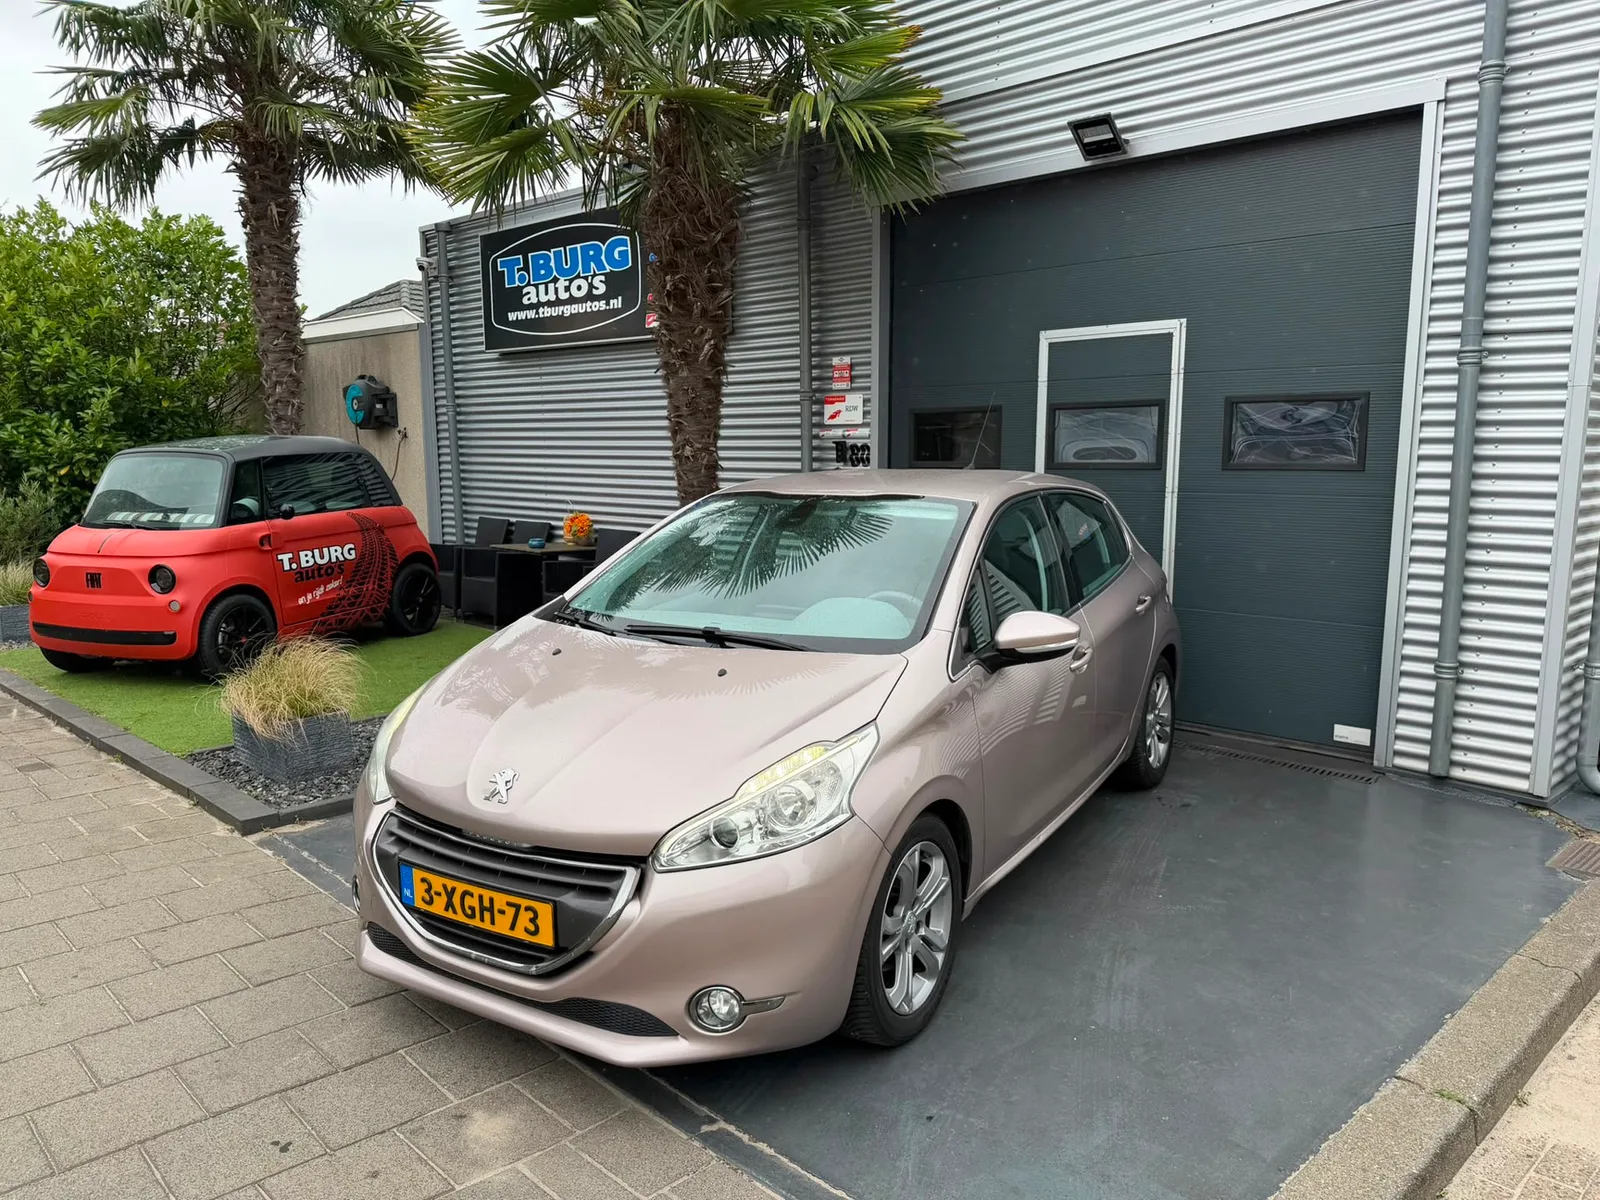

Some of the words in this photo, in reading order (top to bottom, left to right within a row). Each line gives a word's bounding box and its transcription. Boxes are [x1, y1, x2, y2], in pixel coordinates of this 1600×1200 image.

[522, 275, 607, 305] auto's
[507, 296, 622, 322] www.tburgautos.nl
[85, 572, 102, 589] FIAT
[295, 563, 345, 583] auto's
[403, 887, 413, 899] NL
[419, 877, 540, 937] 3-XGH-73
